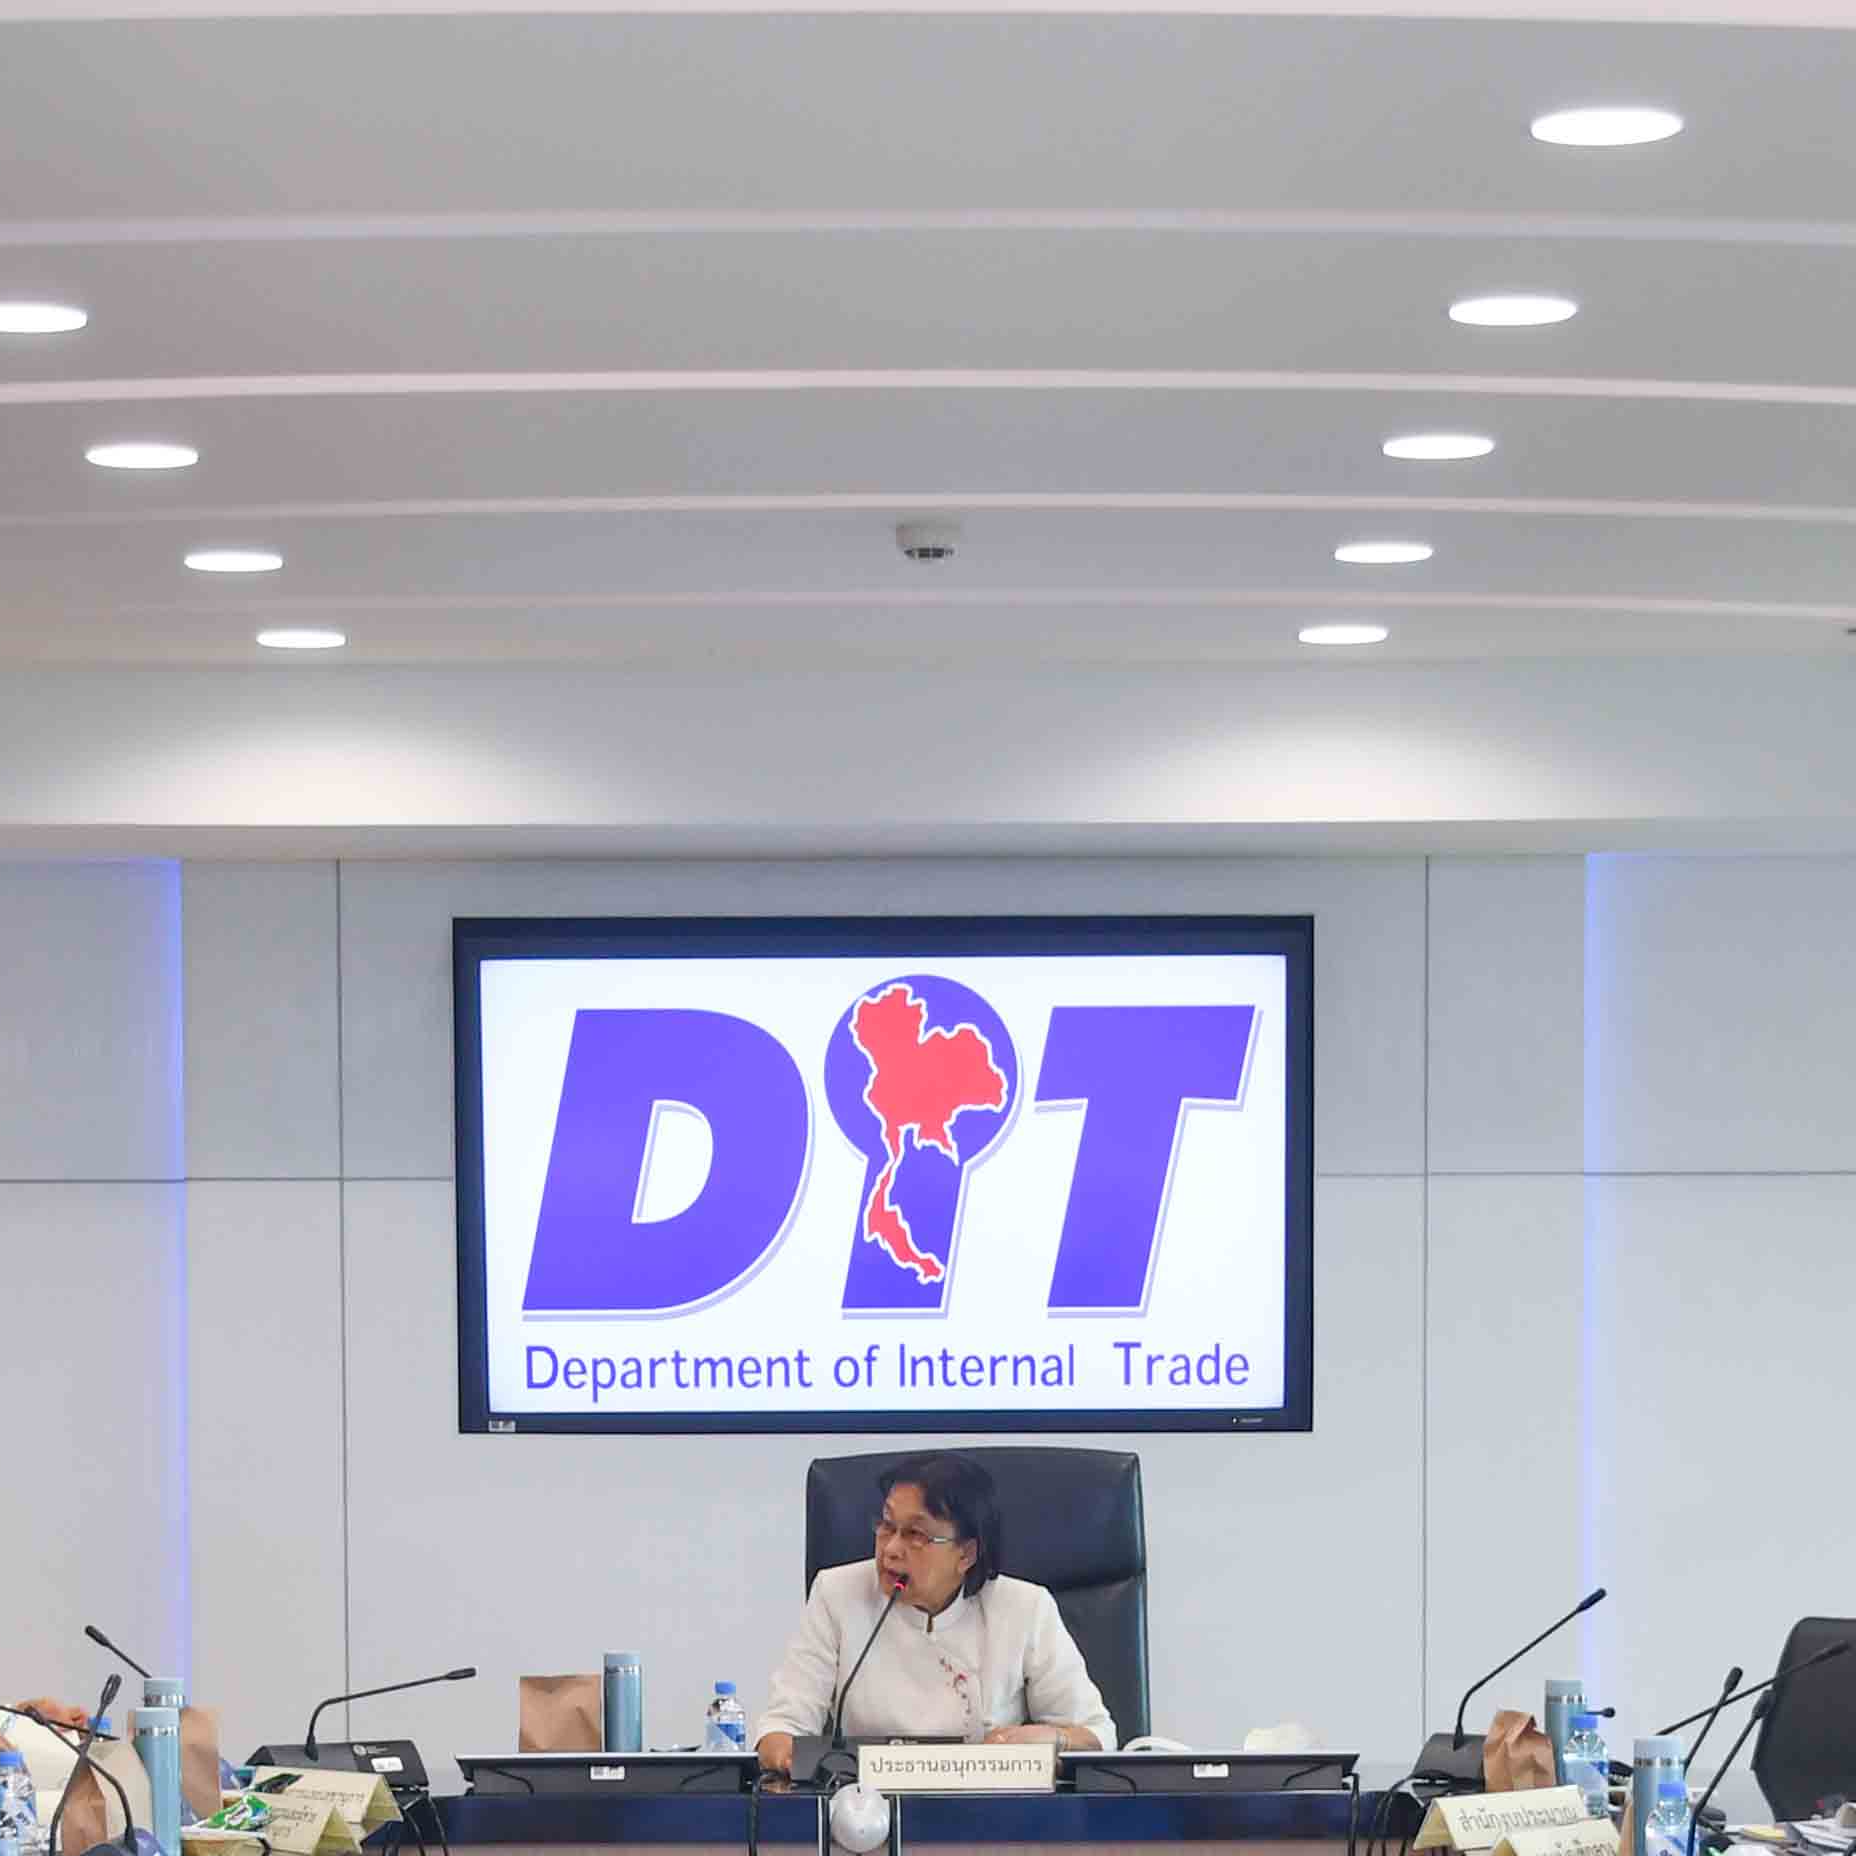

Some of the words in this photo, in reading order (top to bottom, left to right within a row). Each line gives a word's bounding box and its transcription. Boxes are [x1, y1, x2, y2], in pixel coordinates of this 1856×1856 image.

[522, 974, 1260, 1319] DIT
[525, 1346, 813, 1403] Department
[834, 1344, 881, 1388] of
[899, 1343, 1076, 1389] Internal
[1113, 1342, 1251, 1387] Trade
[869, 1755, 1043, 1779] ประธานอนุกรรมการ
